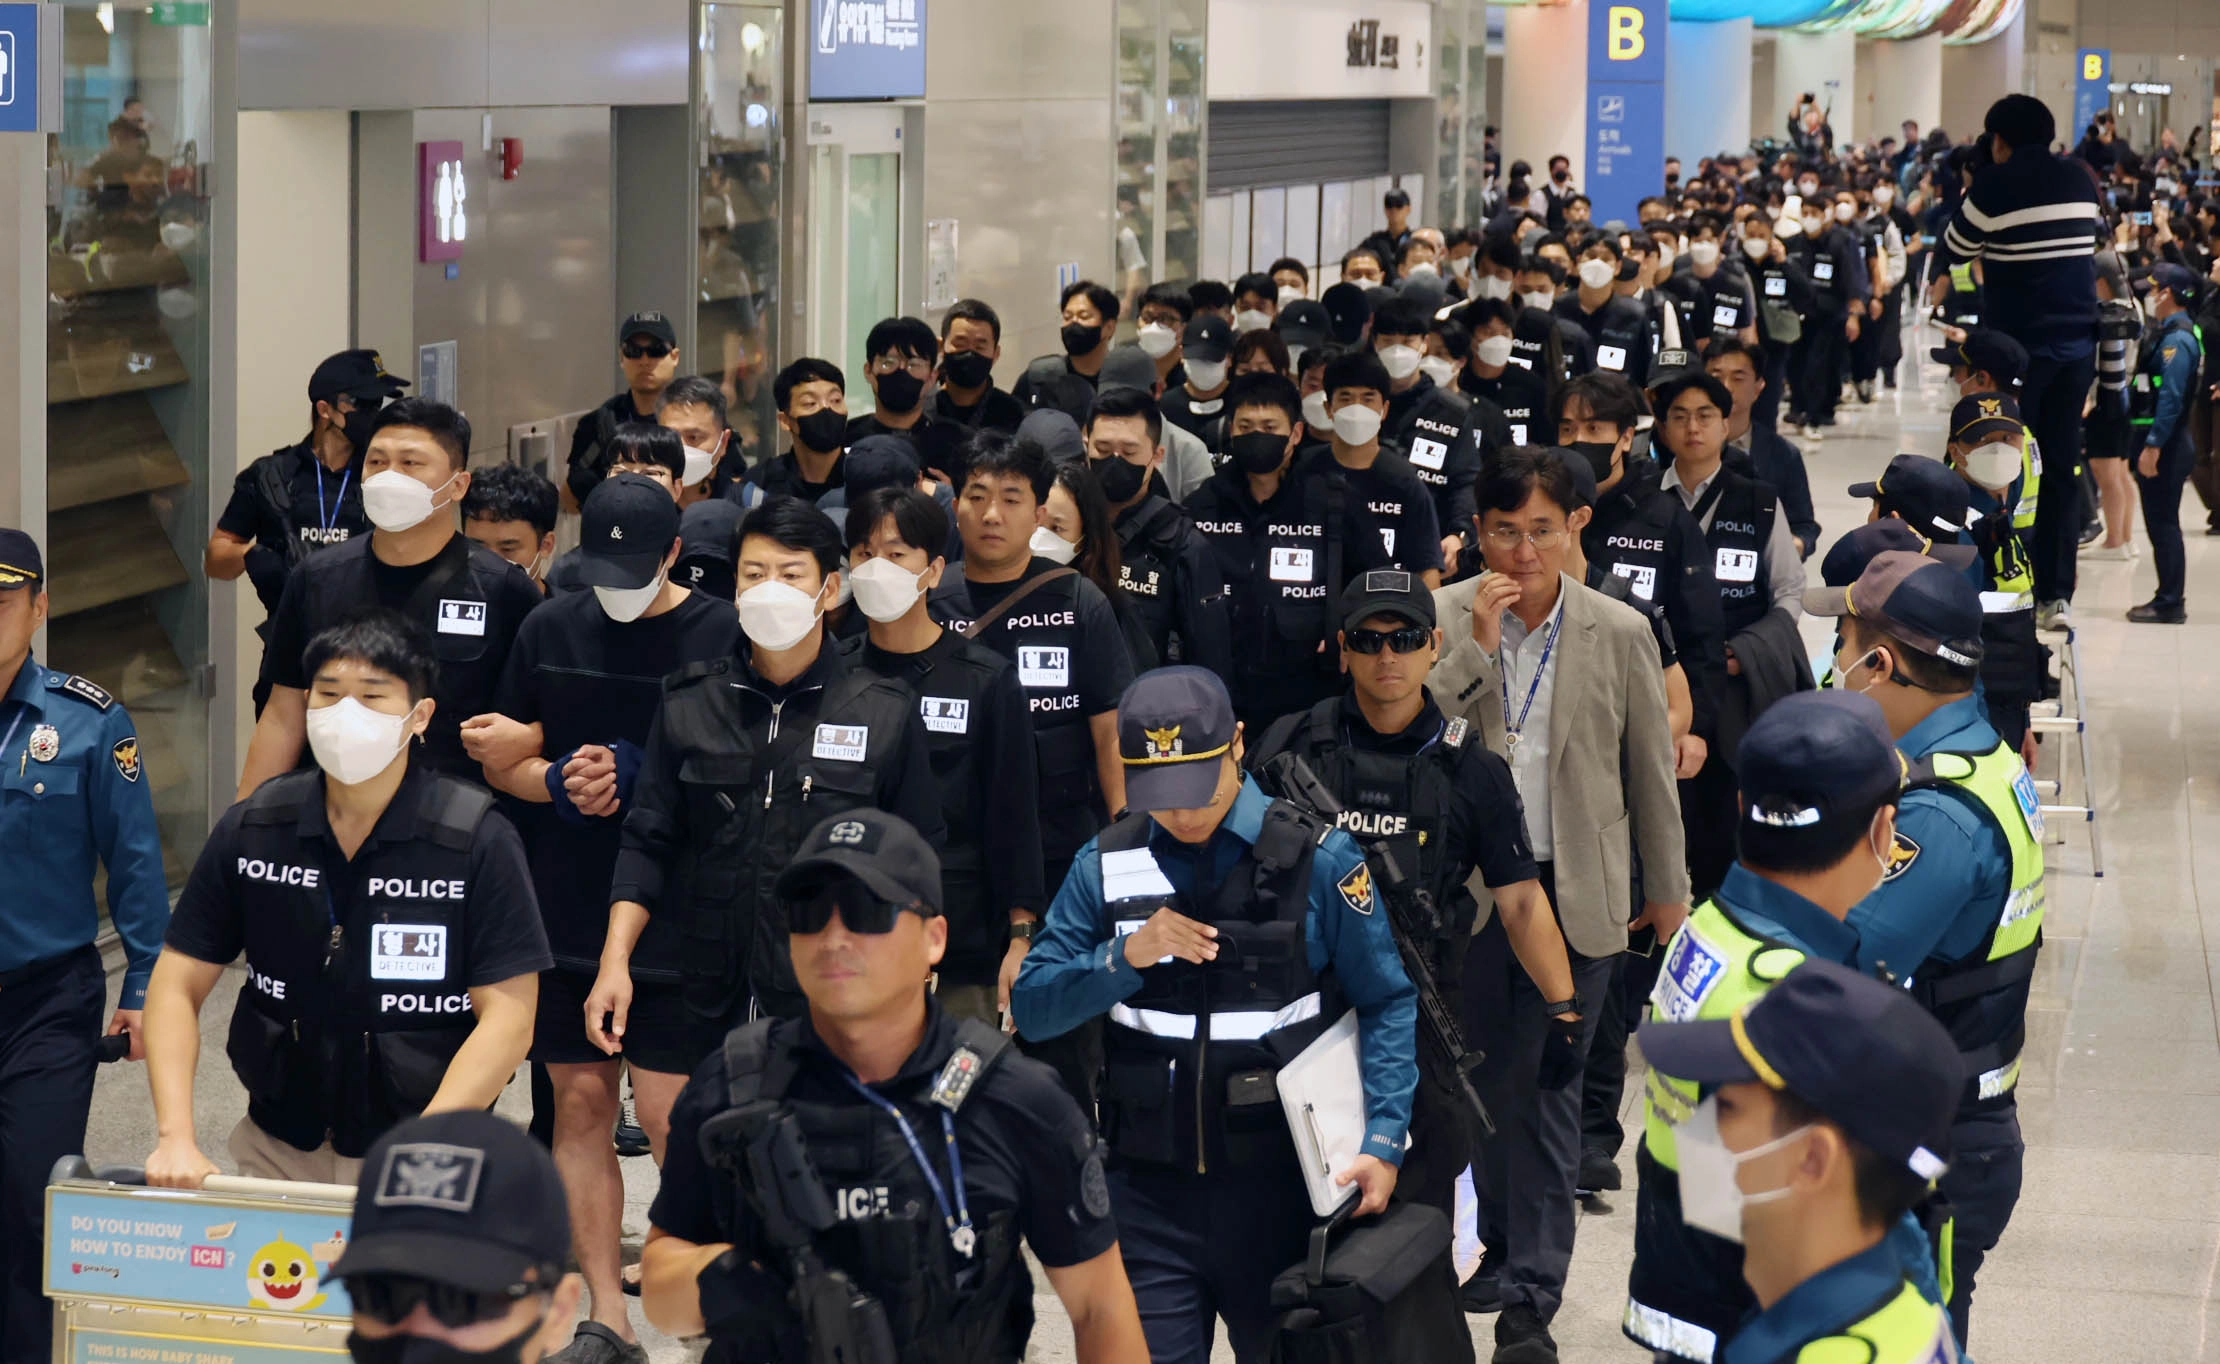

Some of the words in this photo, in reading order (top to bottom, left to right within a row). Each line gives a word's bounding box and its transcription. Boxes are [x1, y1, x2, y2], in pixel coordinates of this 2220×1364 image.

[1608, 6, 1645, 61] B
[2084, 54, 2102, 80] B
[1512, 339, 1542, 351] OLICE
[1503, 408, 1530, 418] LICE
[1416, 418, 1459, 437] POLICE
[1417, 469, 1448, 485] OLIC
[1368, 502, 1402, 514] LICE
[610, 526, 623, 539] &
[1268, 524, 1322, 536] POLICE
[1607, 536, 1664, 551] POLICE
[690, 566, 704, 582] P
[1118, 578, 1158, 595] POLICE
[1282, 585, 1326, 598] POLICE
[1007, 611, 1075, 630] POLICE
[1029, 695, 1080, 712] POLICE
[927, 720, 963, 730] ETECTIVE
[817, 746, 861, 758] DETECTIVE
[1336, 810, 1407, 835] POLICE
[237, 857, 320, 888] POLICE
[368, 877, 465, 899] POLICE
[379, 960, 438, 972] DETECTIVE
[71, 1215, 93, 1231] DO
[97, 1218, 131, 1235] YOU
[134, 1222, 183, 1239] KNOW
[70, 1238, 108, 1256] HOW
[112, 1241, 134, 1257] TO
[136, 1244, 187, 1262] ENJOY
[193, 1249, 223, 1266] ICN
[88, 1343, 113, 1357] THIS
[116, 1346, 128, 1358] IS
[130, 1347, 160, 1361] HOW
[161, 1350, 193, 1364] BABY
